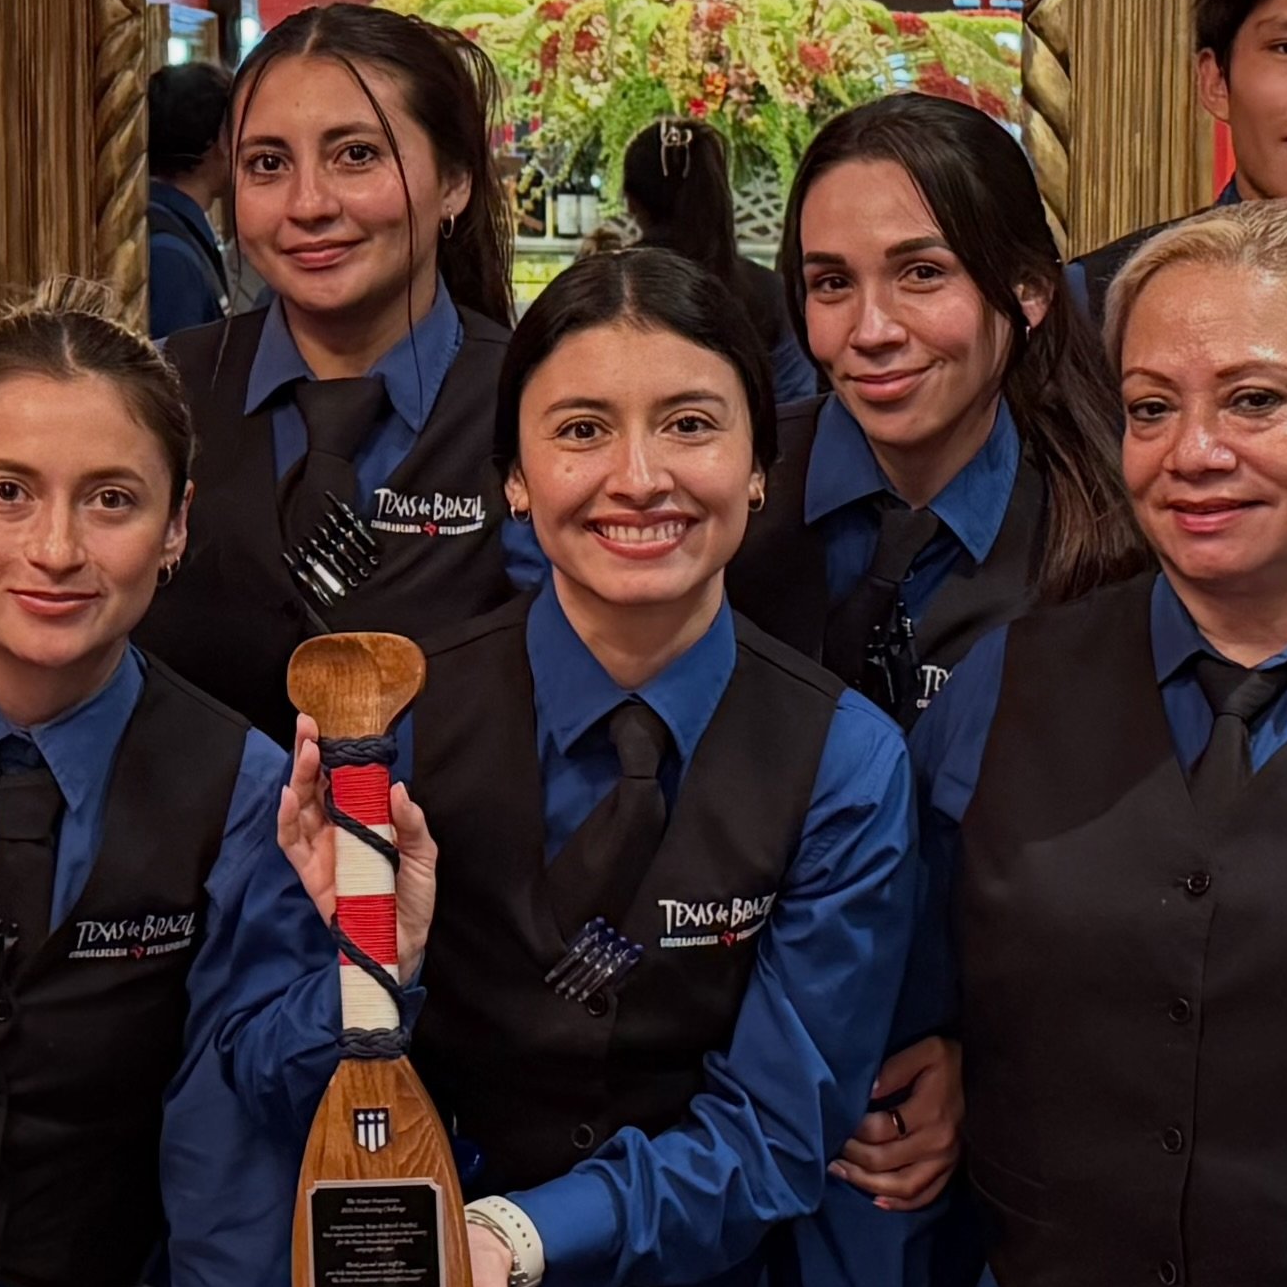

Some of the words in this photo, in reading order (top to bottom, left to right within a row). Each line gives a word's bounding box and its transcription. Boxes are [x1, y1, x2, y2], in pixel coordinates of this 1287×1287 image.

[374, 488, 418, 519] TEXAS
[418, 497, 431, 515] de
[433, 492, 486, 521] BRAZIL
[76, 919, 128, 950] TEXAS
[141, 912, 196, 942] BRAZIL
[658, 899, 715, 935] TEXAS
[715, 903, 729, 925] de
